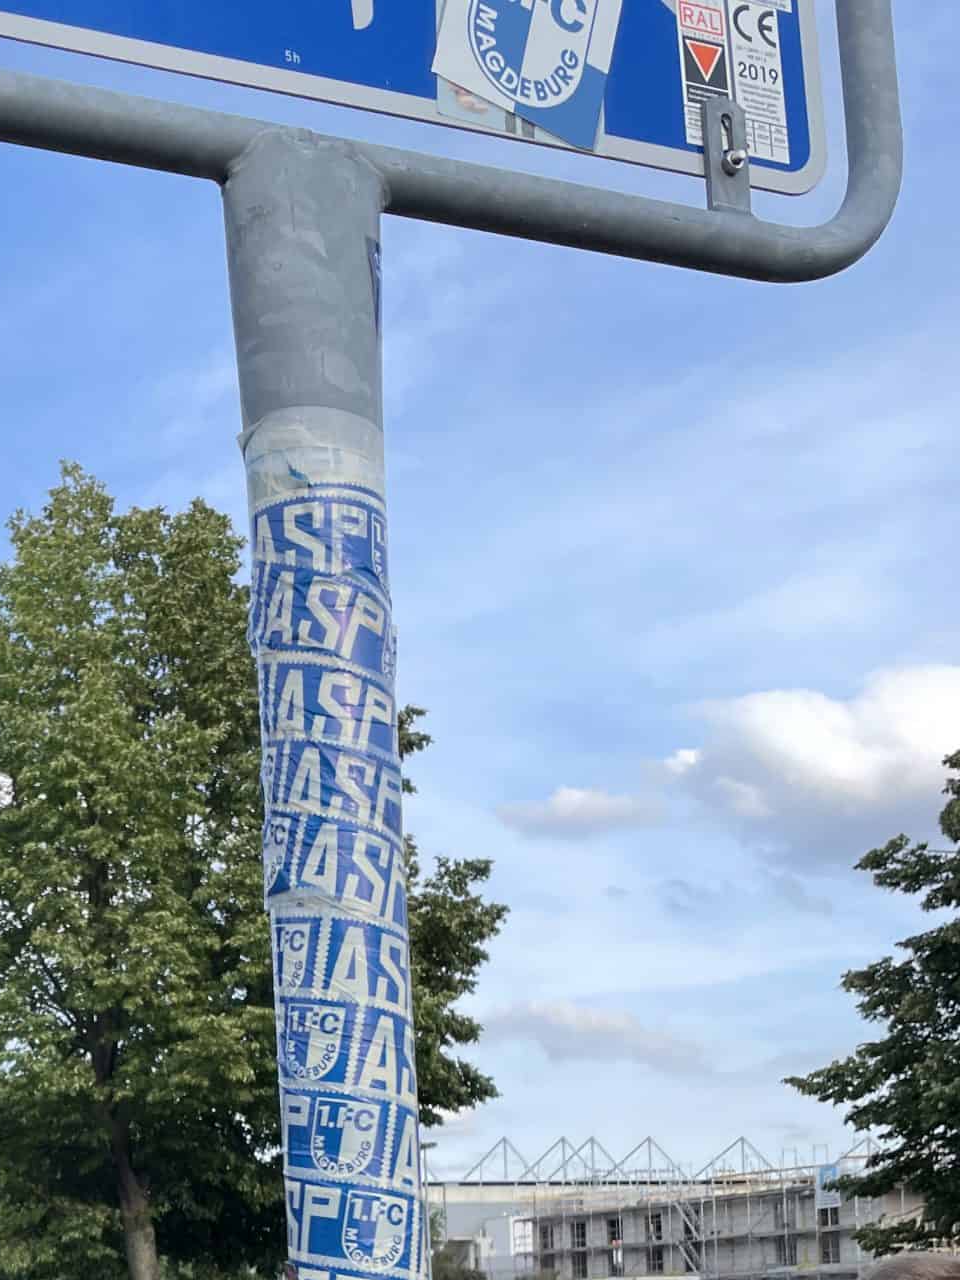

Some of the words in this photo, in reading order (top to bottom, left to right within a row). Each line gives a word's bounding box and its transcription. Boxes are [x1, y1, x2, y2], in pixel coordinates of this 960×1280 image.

[683, 6, 720, 31] RAL
[733, 4, 777, 49] CE
[475, 3, 579, 101] MAGDEBURG
[737, 61, 779, 86] 2019
[263, 571, 384, 660] ASP
[318, 1104, 375, 1132] 1.FC
[351, 1198, 404, 1226] 1.FC
